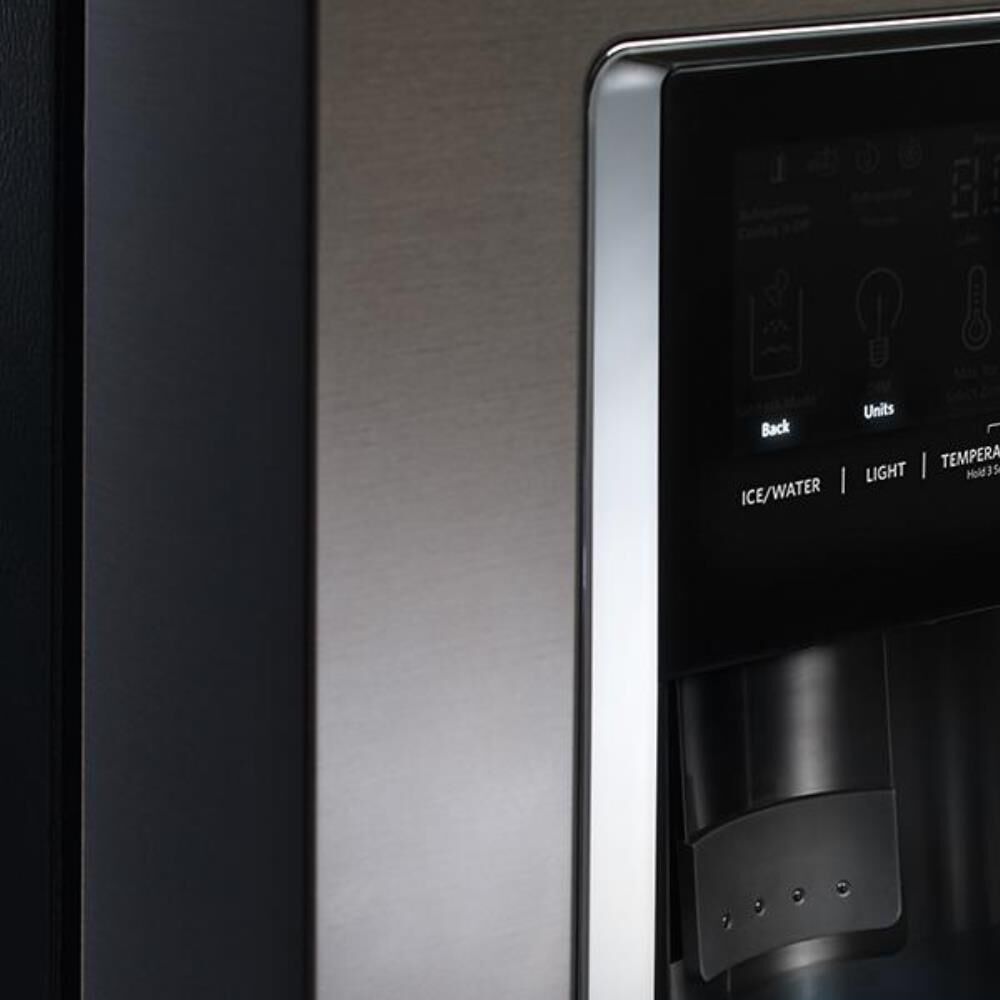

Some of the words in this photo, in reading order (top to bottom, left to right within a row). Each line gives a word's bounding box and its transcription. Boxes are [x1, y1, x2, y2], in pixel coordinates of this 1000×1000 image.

[863, 402, 895, 419] Units
[761, 418, 790, 438] Back
[865, 461, 907, 483] LIGHT
[966, 466, 986, 480] Hold
[986, 465, 993, 476] 3
[741, 477, 821, 506] ICE/WATER
